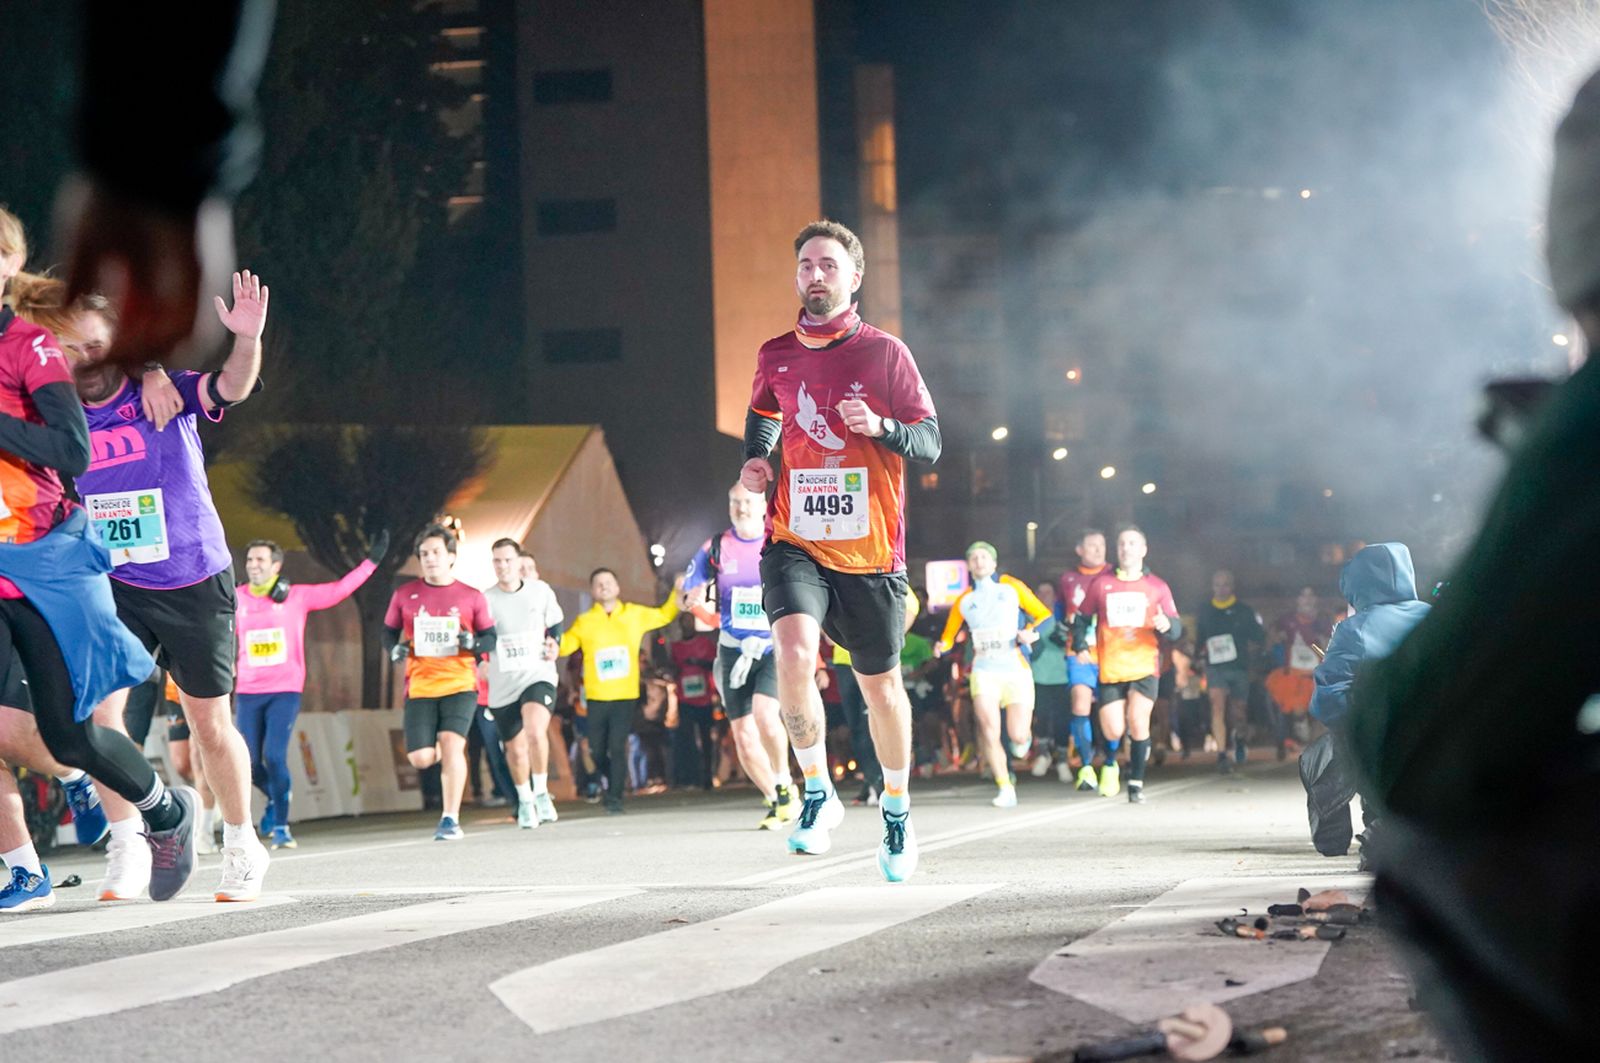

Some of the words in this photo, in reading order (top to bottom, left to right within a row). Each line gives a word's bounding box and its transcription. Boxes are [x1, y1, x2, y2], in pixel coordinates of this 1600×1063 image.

[809, 420, 827, 439] 43
[805, 476, 828, 485] NOCHE
[829, 475, 838, 484] DE
[797, 485, 811, 494] SAN
[100, 500, 121, 509] NOCHE
[121, 500, 131, 508] DE
[803, 494, 854, 516] 4493
[94, 511, 107, 519] SAN
[107, 517, 142, 542] 261
[424, 631, 450, 643] 7088
